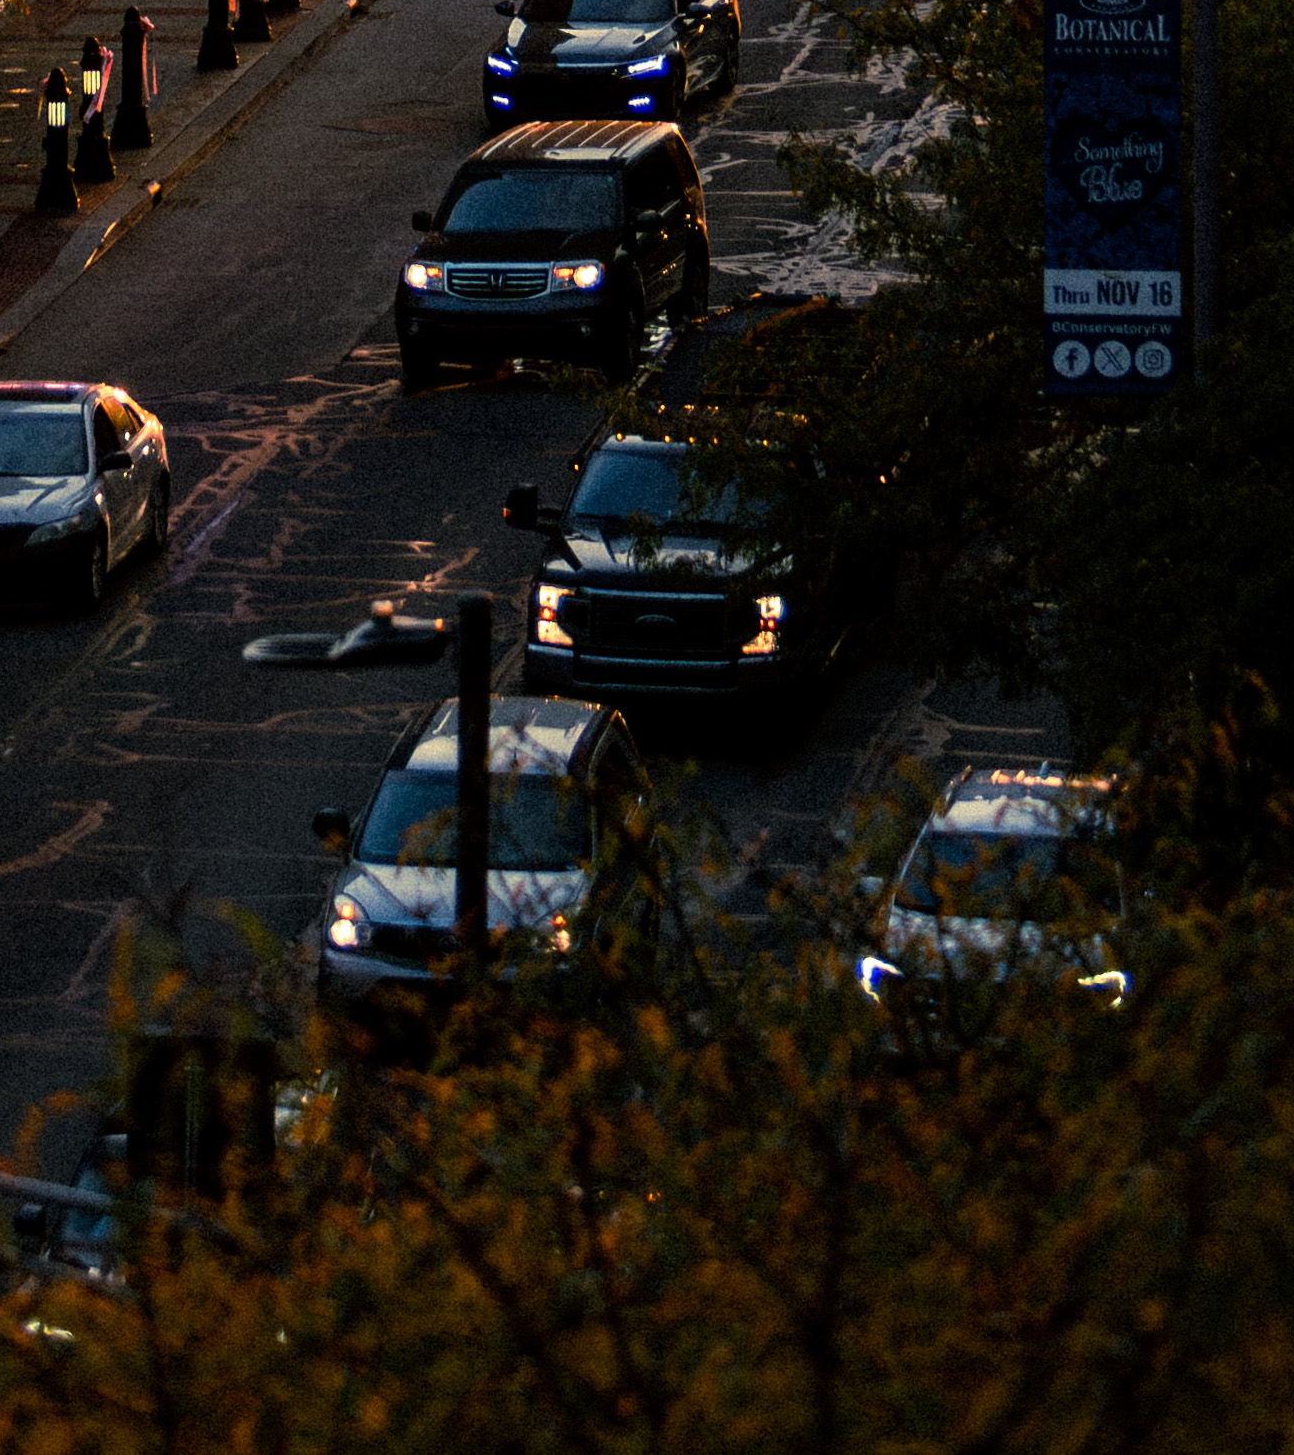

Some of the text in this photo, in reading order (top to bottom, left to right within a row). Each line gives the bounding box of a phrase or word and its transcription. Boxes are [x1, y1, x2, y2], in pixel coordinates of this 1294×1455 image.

[1054, 11, 1172, 43] BOTANICAL
[1073, 130, 1164, 175] Something
[1078, 160, 1144, 204] Blue
[1052, 280, 1173, 307] Thru NOV 16
